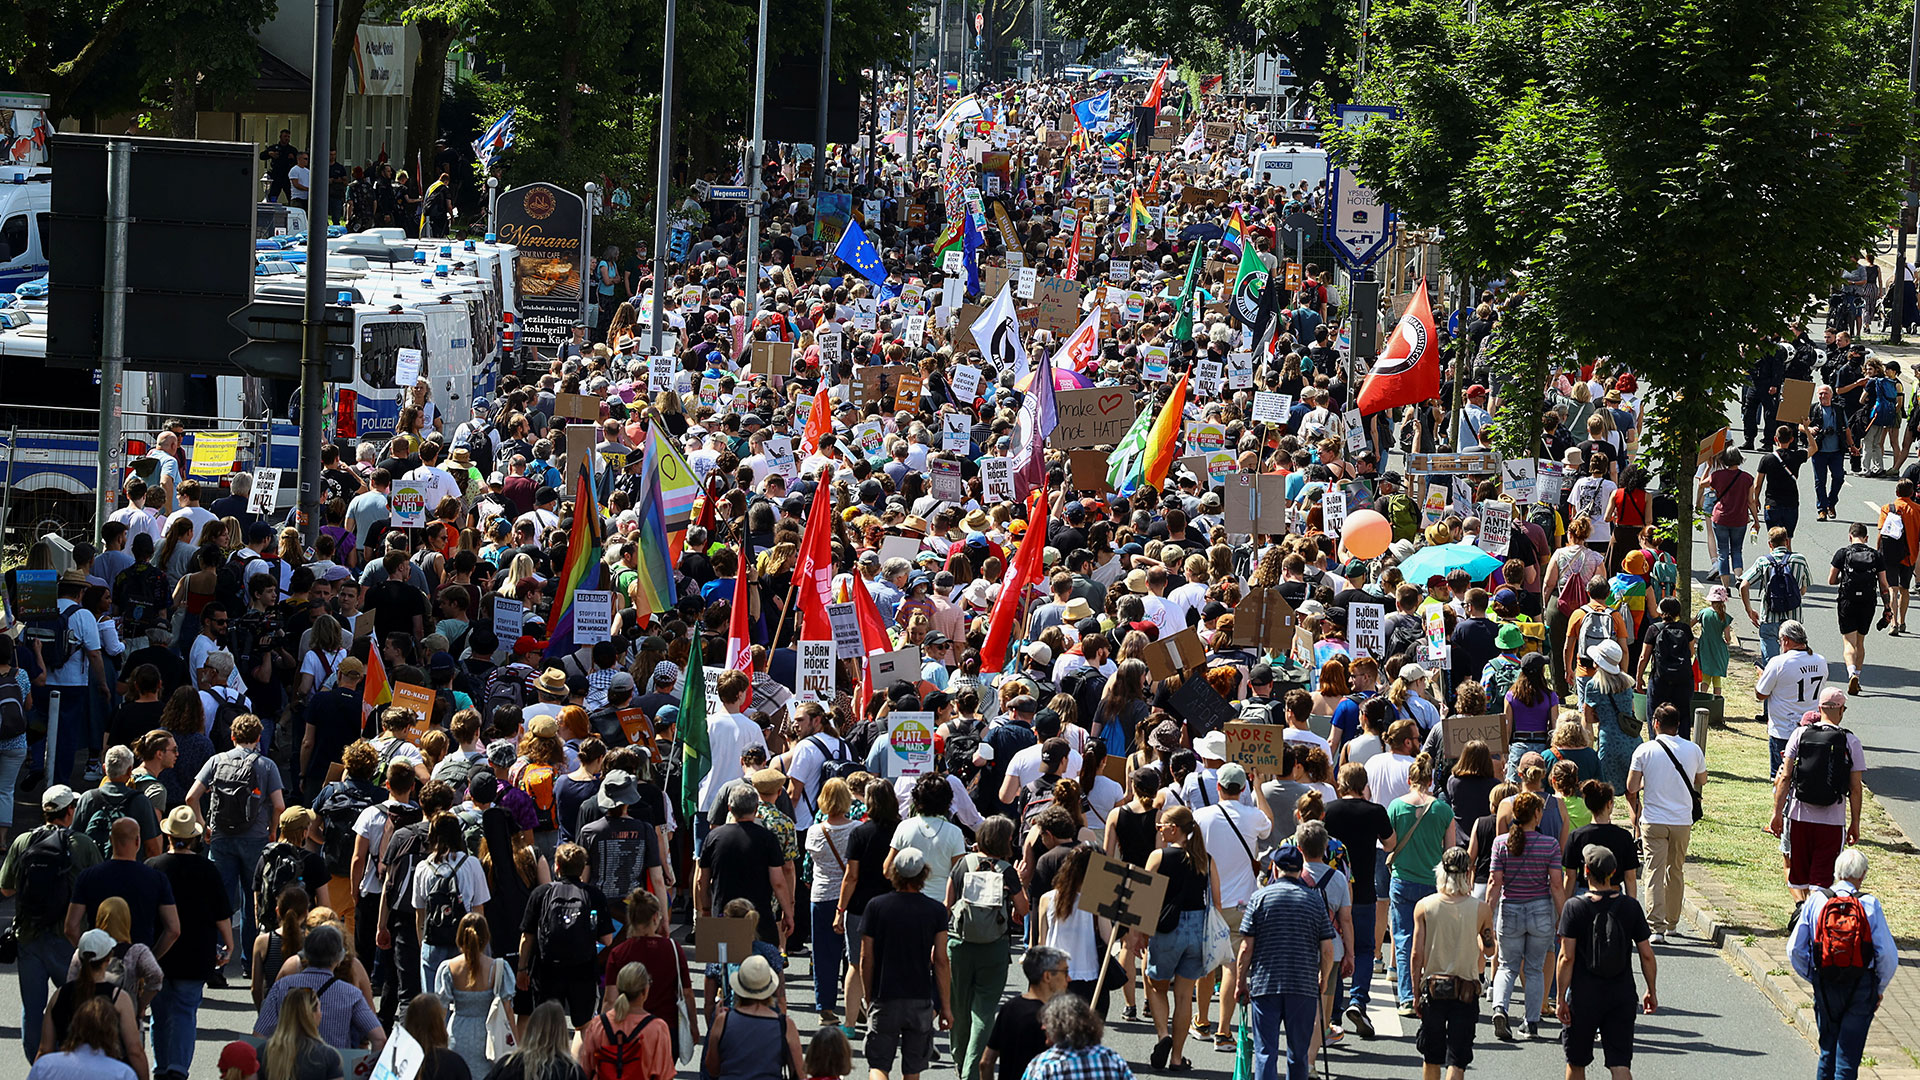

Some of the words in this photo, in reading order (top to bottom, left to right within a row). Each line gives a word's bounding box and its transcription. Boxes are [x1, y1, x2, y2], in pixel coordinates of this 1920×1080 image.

[1265, 161, 1292, 169] POLIZEI
[713, 189, 748, 199] Wegenerstr.
[1347, 197, 1376, 206] HOTEL
[498, 223, 580, 250] Nirvana
[1044, 277, 1074, 293] AfD
[1041, 293, 1060, 303] Aus
[522, 324, 567, 336] kohlegrill
[958, 371, 974, 380] OMAS
[956, 377, 975, 387] GEGEN
[953, 383, 974, 393] RECHTS
[1058, 400, 1096, 418] make
[362, 418, 396, 430] POLIZEI
[1060, 424, 1086, 441] not
[1093, 418, 1130, 438] HATE
[986, 459, 1007, 471] BJÖRN
[987, 470, 1008, 480] HÖCKE
[935, 479, 956, 489] GEGEN
[988, 482, 1009, 495] NAZI
[1504, 481, 1513, 490] NIE
[395, 493, 420, 503] STOPPT
[401, 503, 417, 513] AFD
[1486, 509, 1496, 517] DO
[1497, 511, 1509, 519] THE
[1484, 516, 1509, 528] ANTI
[1483, 525, 1508, 536] RIGHT
[1483, 533, 1507, 543] THING
[578, 594, 590, 602] AFD
[590, 594, 608, 602] RAUS!
[497, 601, 506, 609] AFD
[506, 603, 520, 612] RAUS!
[830, 607, 840, 615] AFD
[840, 606, 853, 614] RAUS!
[1356, 605, 1379, 618] BJÖRN
[1356, 617, 1379, 630] HÖCKE
[1356, 634, 1379, 650] NAZI
[804, 643, 830, 657] BJÖRN
[804, 656, 829, 670] HÖCKE
[1799, 664, 1818, 674] Willi
[803, 674, 829, 691] NAZI
[1797, 675, 1823, 702] 17
[399, 688, 430, 701] AFD-NAZIS
[903, 722, 918, 731] KEIN
[896, 730, 922, 742] PLATZ
[1225, 728, 1272, 744] MORE
[1452, 727, 1478, 744] FCK
[905, 742, 925, 751] NAZIS
[1231, 752, 1253, 764] LESS
[1256, 755, 1278, 766] HATE
[630, 830, 639, 839] 77
